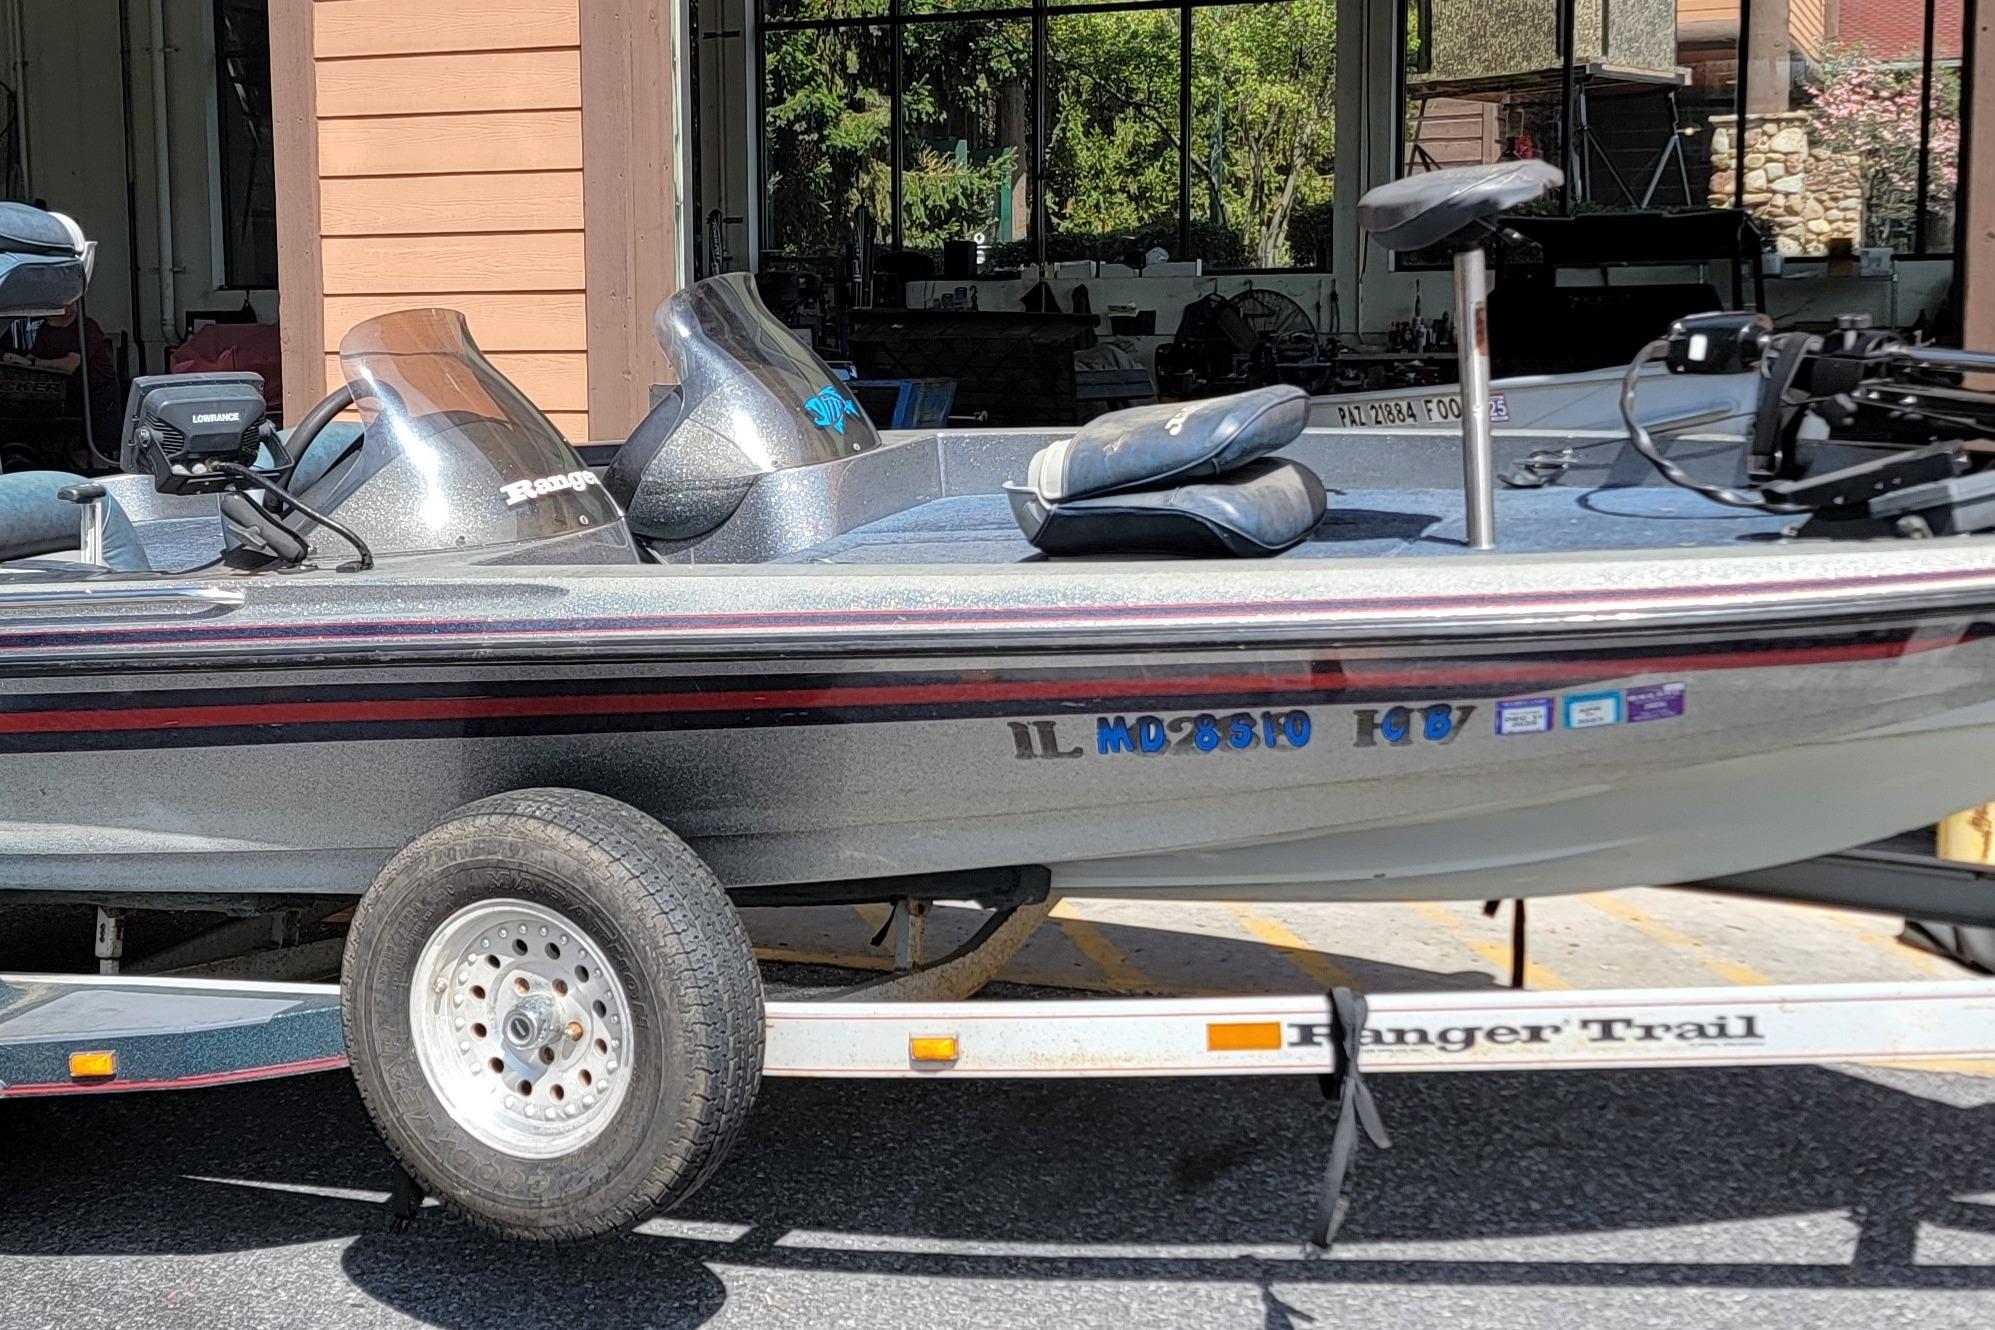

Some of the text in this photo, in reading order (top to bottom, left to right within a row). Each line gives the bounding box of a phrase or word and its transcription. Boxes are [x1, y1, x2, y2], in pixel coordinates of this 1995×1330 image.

[192, 412, 240, 424] LOWRANCE
[1338, 405, 1367, 428] PAZ
[1369, 400, 1418, 426] 21884
[1580, 1014, 1765, 1042] Trail
